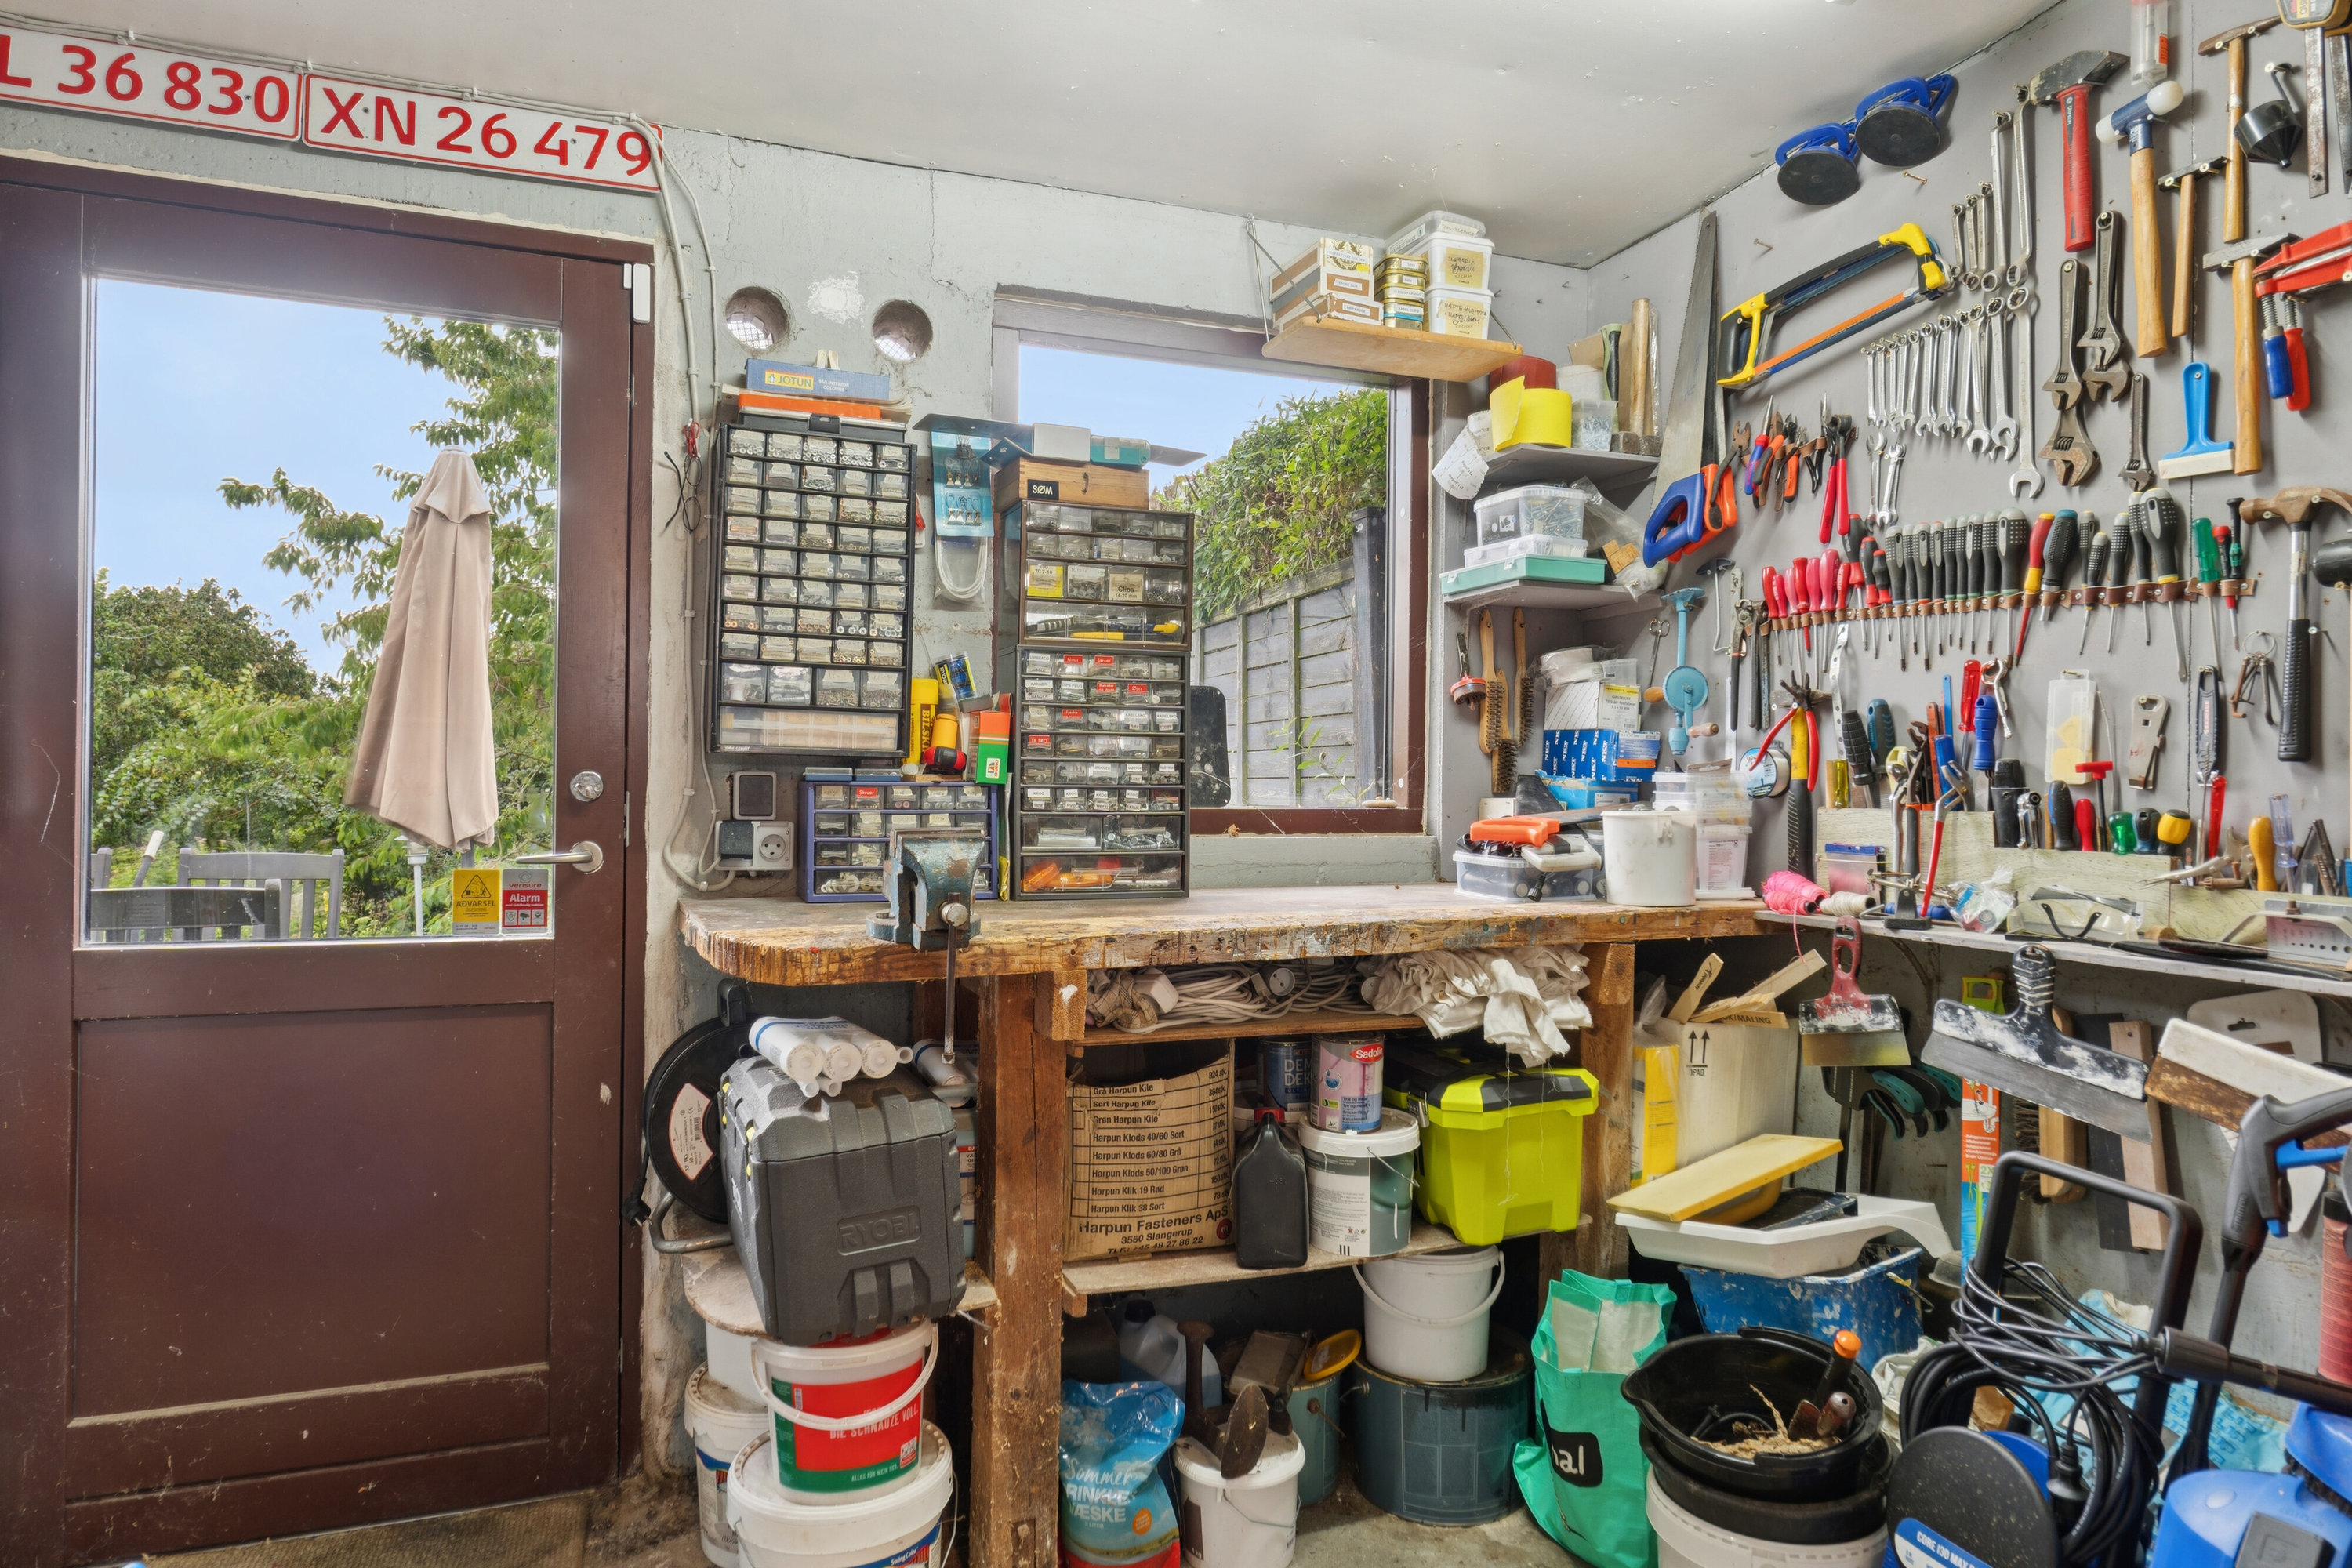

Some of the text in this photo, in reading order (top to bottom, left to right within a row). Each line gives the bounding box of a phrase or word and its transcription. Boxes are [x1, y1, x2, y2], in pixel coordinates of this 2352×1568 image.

[57, 45, 143, 103] 36
[165, 61, 289, 123] 830
[321, 86, 652, 176] XN 26 479
[777, 376, 813, 387] JOTUN
[1032, 485, 1053, 495] SØM
[1117, 585, 1134, 593] Clips
[509, 893, 541, 902] Alarm
[1356, 1046, 1383, 1059] Sadolin
[1109, 1086, 1137, 1096] Harpun
[1139, 1083, 1153, 1092] Kile
[1112, 1116, 1142, 1125] Harpun
[1143, 1115, 1159, 1123] Kile
[1093, 1134, 1121, 1143] Harpun
[1123, 1133, 1145, 1142] Klods
[1147, 1131, 1168, 1141] 40/60
[1170, 1130, 1185, 1138] Sort
[1092, 1152, 1121, 1161] Harpun
[1123, 1151, 1145, 1160] Klods
[1146, 1149, 1168, 1159] 60/80
[1170, 1148, 1181, 1158] Grå
[1092, 1169, 1121, 1178] Harpun
[1123, 1168, 1144, 1177] Klods
[1146, 1166, 1171, 1176] 50/100
[1173, 1165, 1189, 1174] Grøn
[1091, 1187, 1120, 1196] Harpun
[1122, 1185, 1137, 1195] Klik
[1140, 1185, 1149, 1194] 19
[1150, 1185, 1165, 1194] Rød
[1091, 1205, 1120, 1214] Harpun
[1121, 1203, 1136, 1213] Klik
[1149, 1202, 1165, 1210] Sort
[1079, 1205, 1229, 1236] Harpun Fasteners ApS
[1121, 1228, 1193, 1244] 3550 Slangerup
[1179, 1238, 1189, 1247] 86
[1192, 1236, 1203, 1244] 22
[829, 1428, 847, 1439] DIE
[851, 1416, 900, 1437] SCHNAUZE
[851, 1473, 866, 1482] ALLES
[866, 1470, 876, 1479] FÜR
[877, 1468, 888, 1477] MEIN
[1065, 1457, 1133, 1486] Sommer
[1916, 1530, 1937, 1552] CORE
